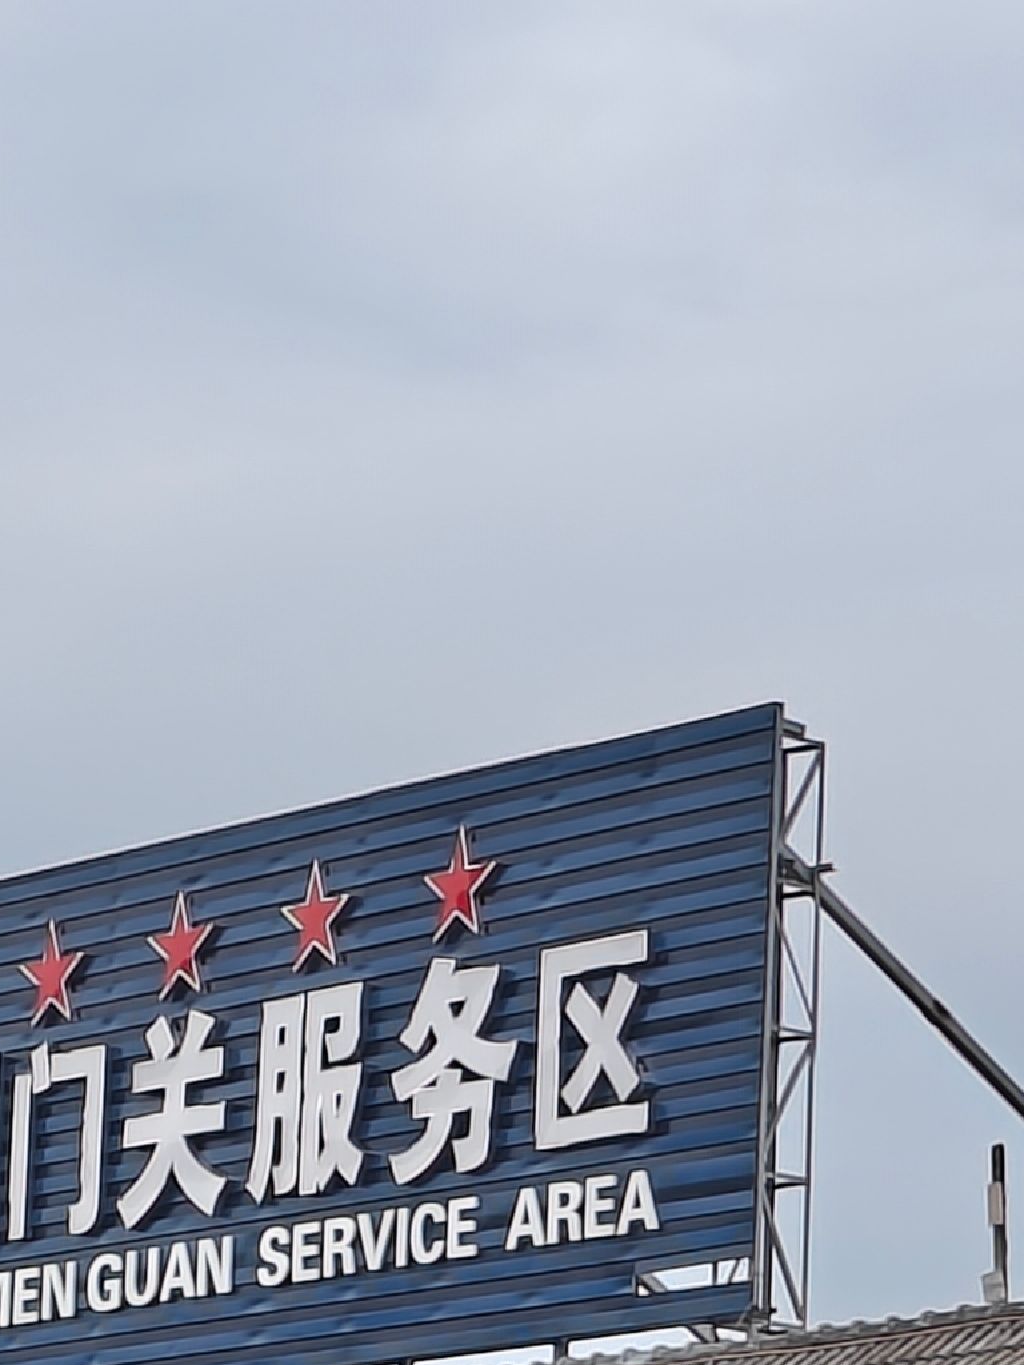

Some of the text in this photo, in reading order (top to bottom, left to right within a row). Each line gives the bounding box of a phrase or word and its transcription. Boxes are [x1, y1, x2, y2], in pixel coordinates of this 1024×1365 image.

[87, 1235, 233, 1312] GUAN
[256, 1196, 480, 1287] SERVICE
[505, 1169, 660, 1252] AREA
